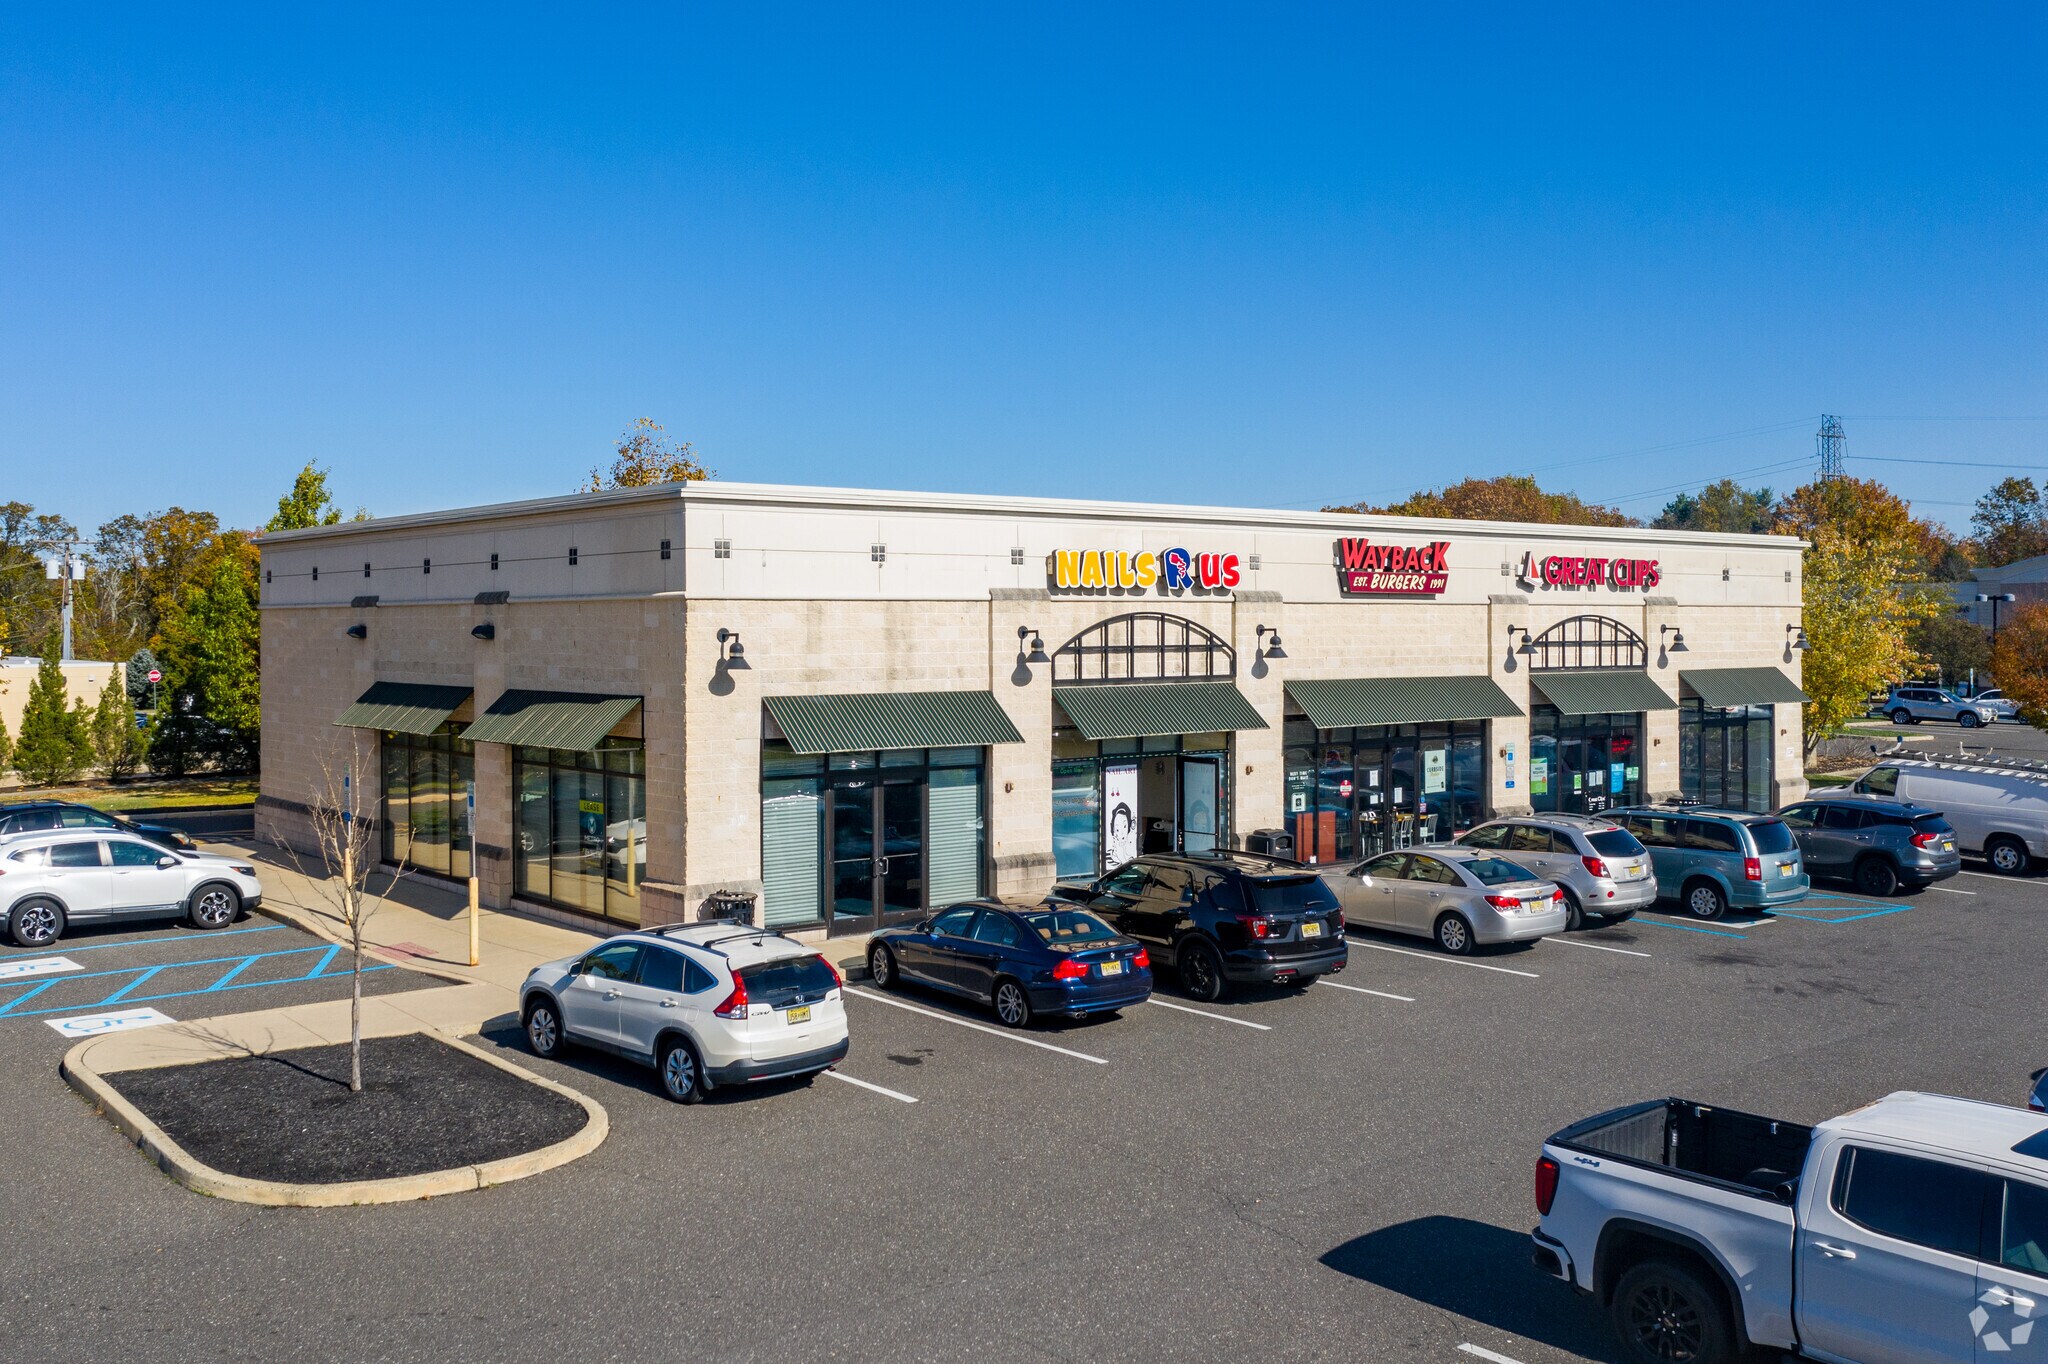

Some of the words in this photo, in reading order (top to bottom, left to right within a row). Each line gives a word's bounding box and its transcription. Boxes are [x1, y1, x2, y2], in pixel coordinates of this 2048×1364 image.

[1056, 549, 1158, 589] NAILS
[1164, 547, 1195, 589] R
[1200, 553, 1240, 589] US
[1341, 537, 1451, 571] WAYBACK
[1352, 576, 1368, 587] EST.
[1370, 573, 1427, 590] BURGERS
[1429, 578, 1445, 589] 1991
[1545, 555, 1608, 586] GREAT
[1613, 558, 1659, 588] CLIPS
[583, 802, 600, 812] LEASE
